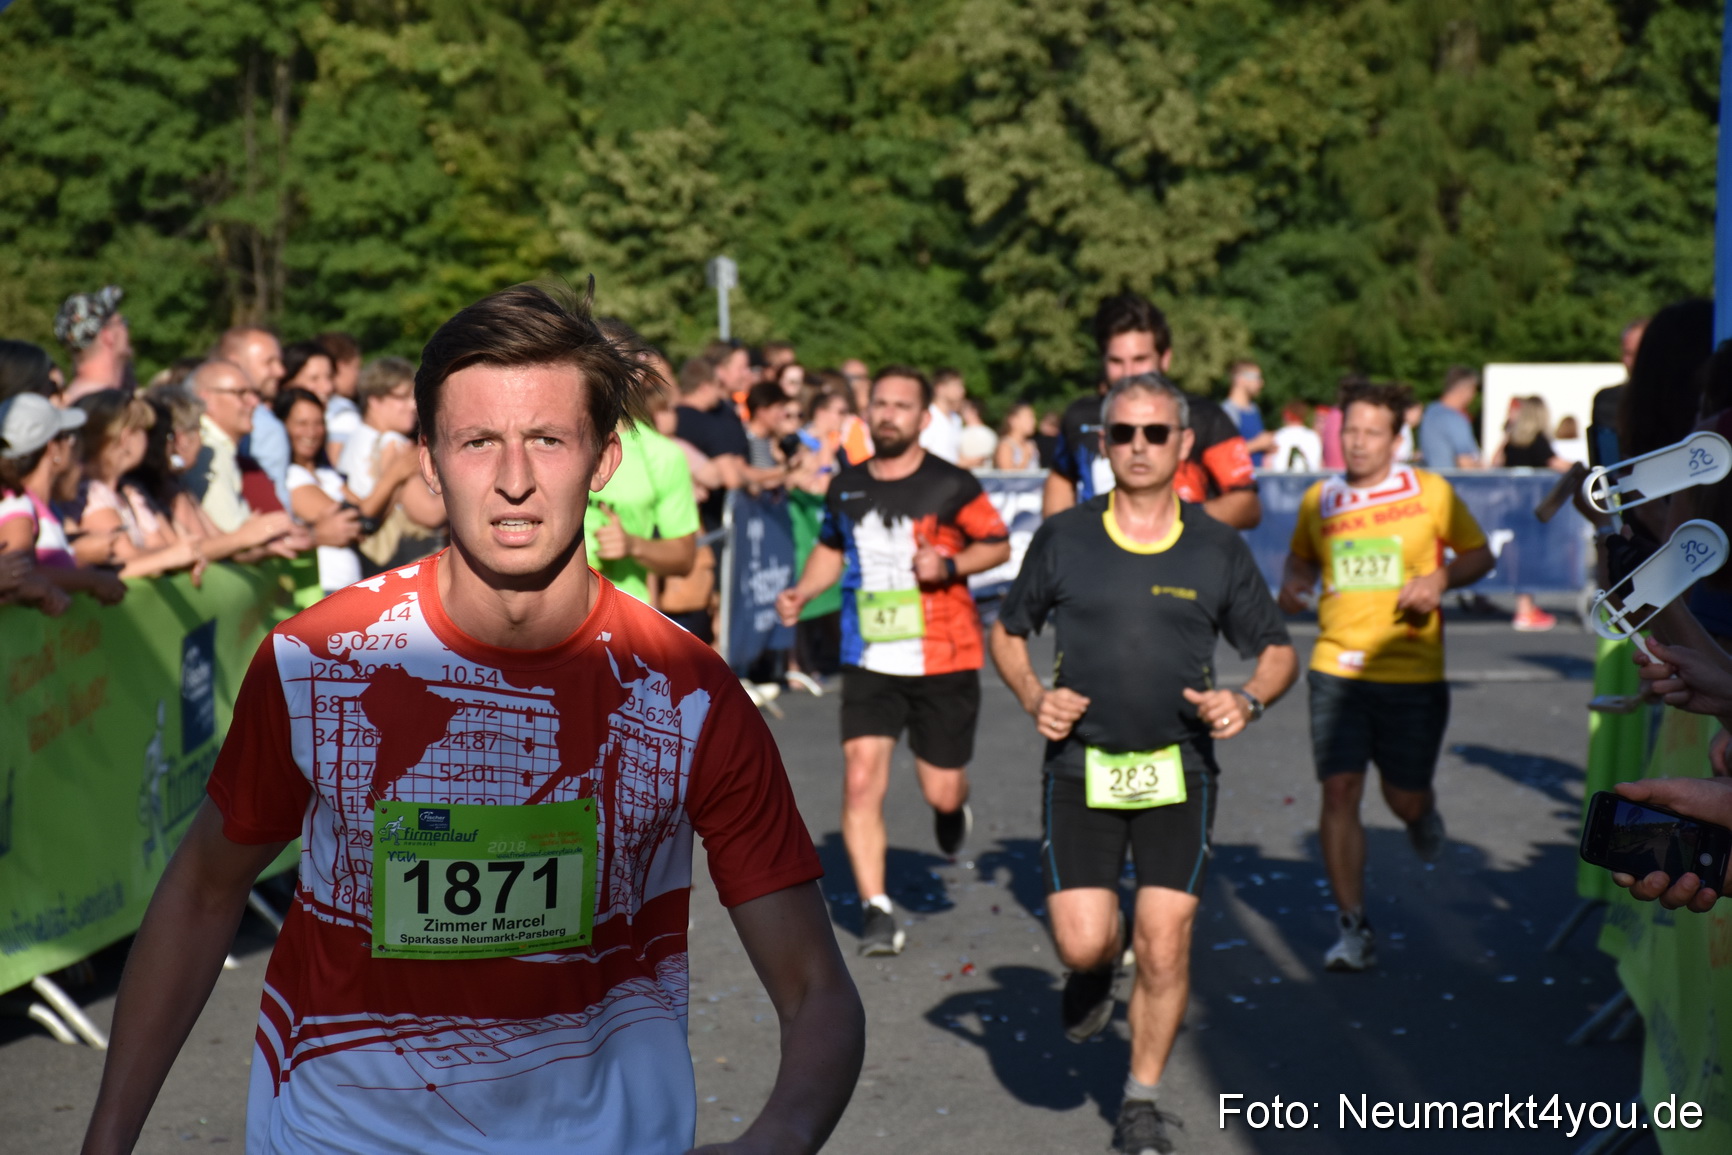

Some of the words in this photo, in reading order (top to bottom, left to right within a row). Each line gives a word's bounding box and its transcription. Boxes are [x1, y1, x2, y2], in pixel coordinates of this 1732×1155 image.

[1342, 555, 1391, 577] 1237
[384, 606, 411, 622] 14
[874, 606, 897, 625] 47
[441, 665, 500, 687] 10.54
[403, 827, 480, 843] firmenlauf
[487, 841, 526, 853] 2018
[404, 857, 558, 916] 1871
[423, 919, 487, 932] Zimmer
[492, 914, 545, 931] Marcel
[400, 934, 458, 945] Sparkasse
[461, 927, 566, 944] Neumarkt-Parsberg
